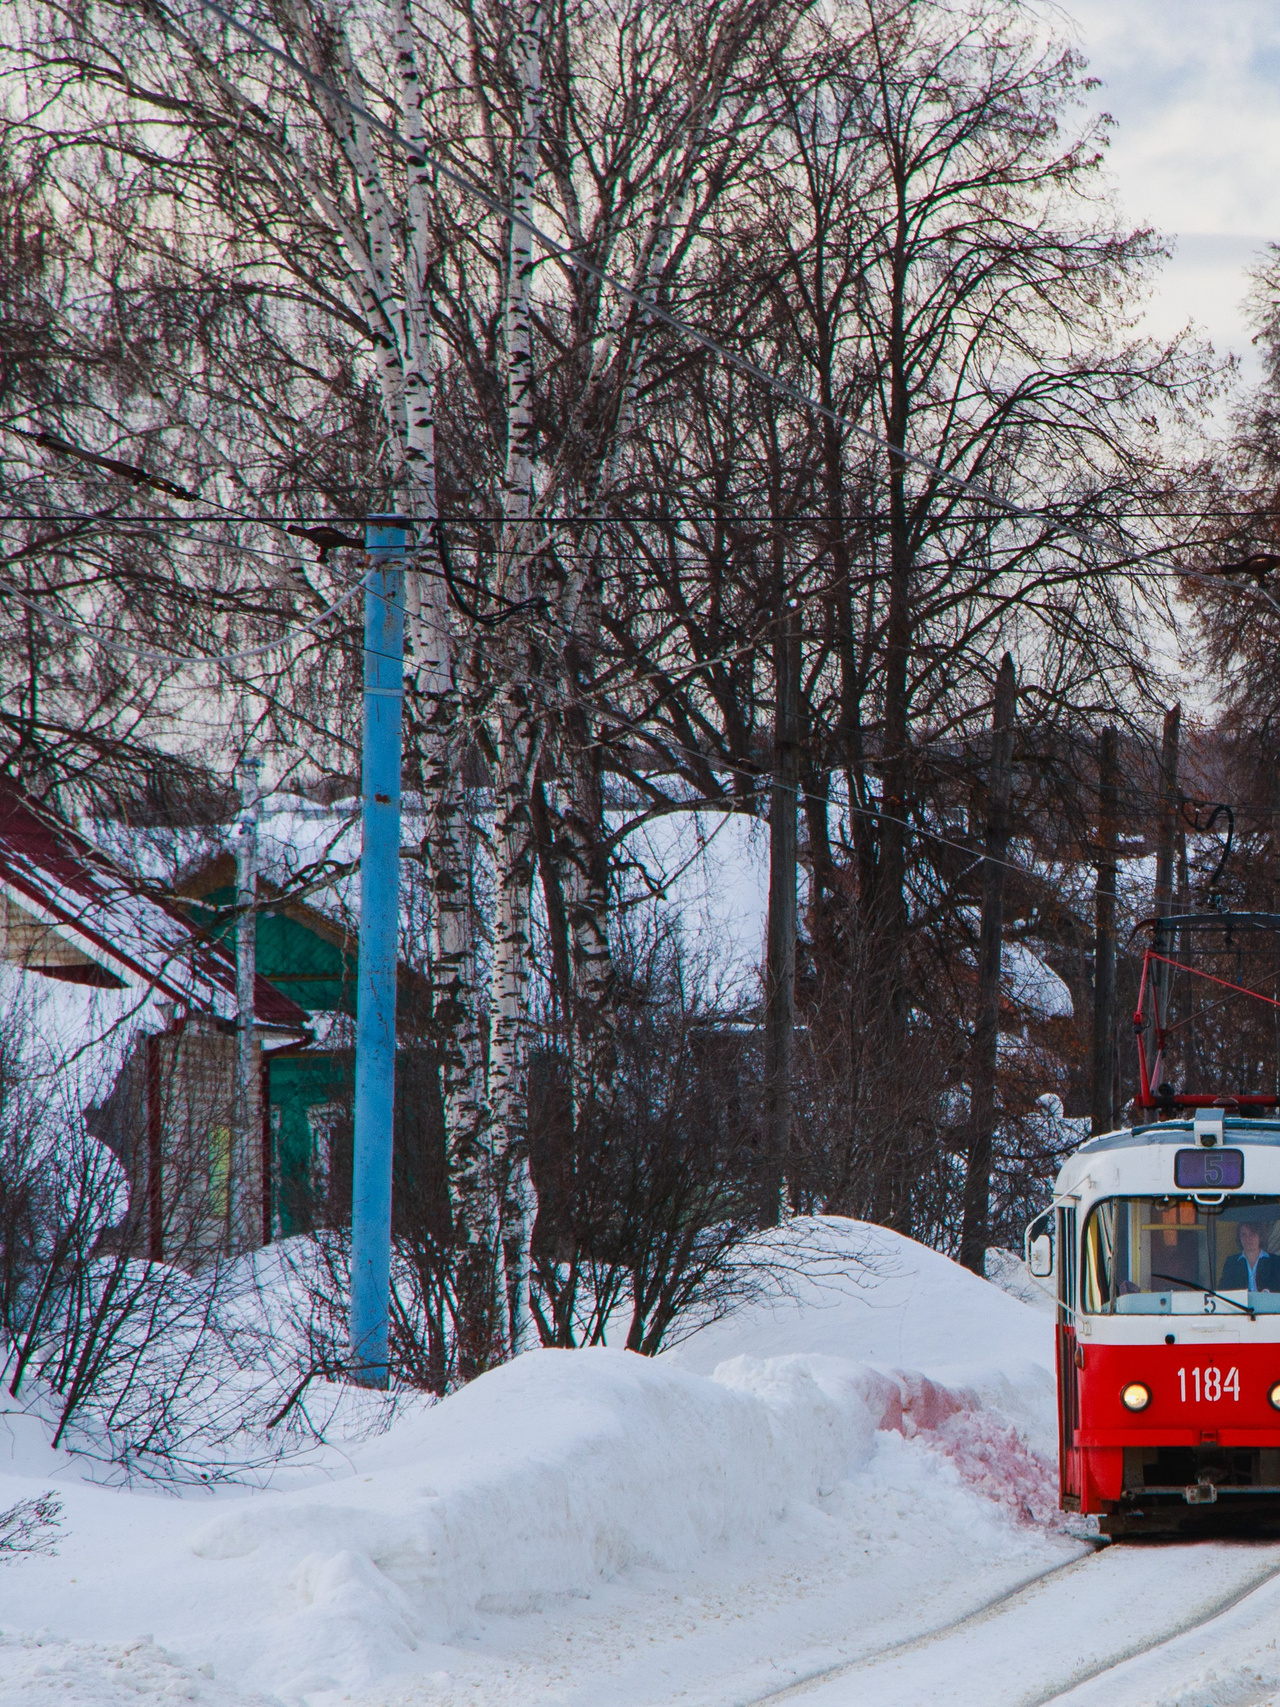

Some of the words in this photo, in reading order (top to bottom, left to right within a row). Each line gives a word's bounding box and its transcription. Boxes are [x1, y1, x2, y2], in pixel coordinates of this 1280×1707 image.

[1204, 1153, 1223, 1186] 5
[1203, 1293, 1217, 1314] 5
[1177, 1366, 1241, 1402] 1184
